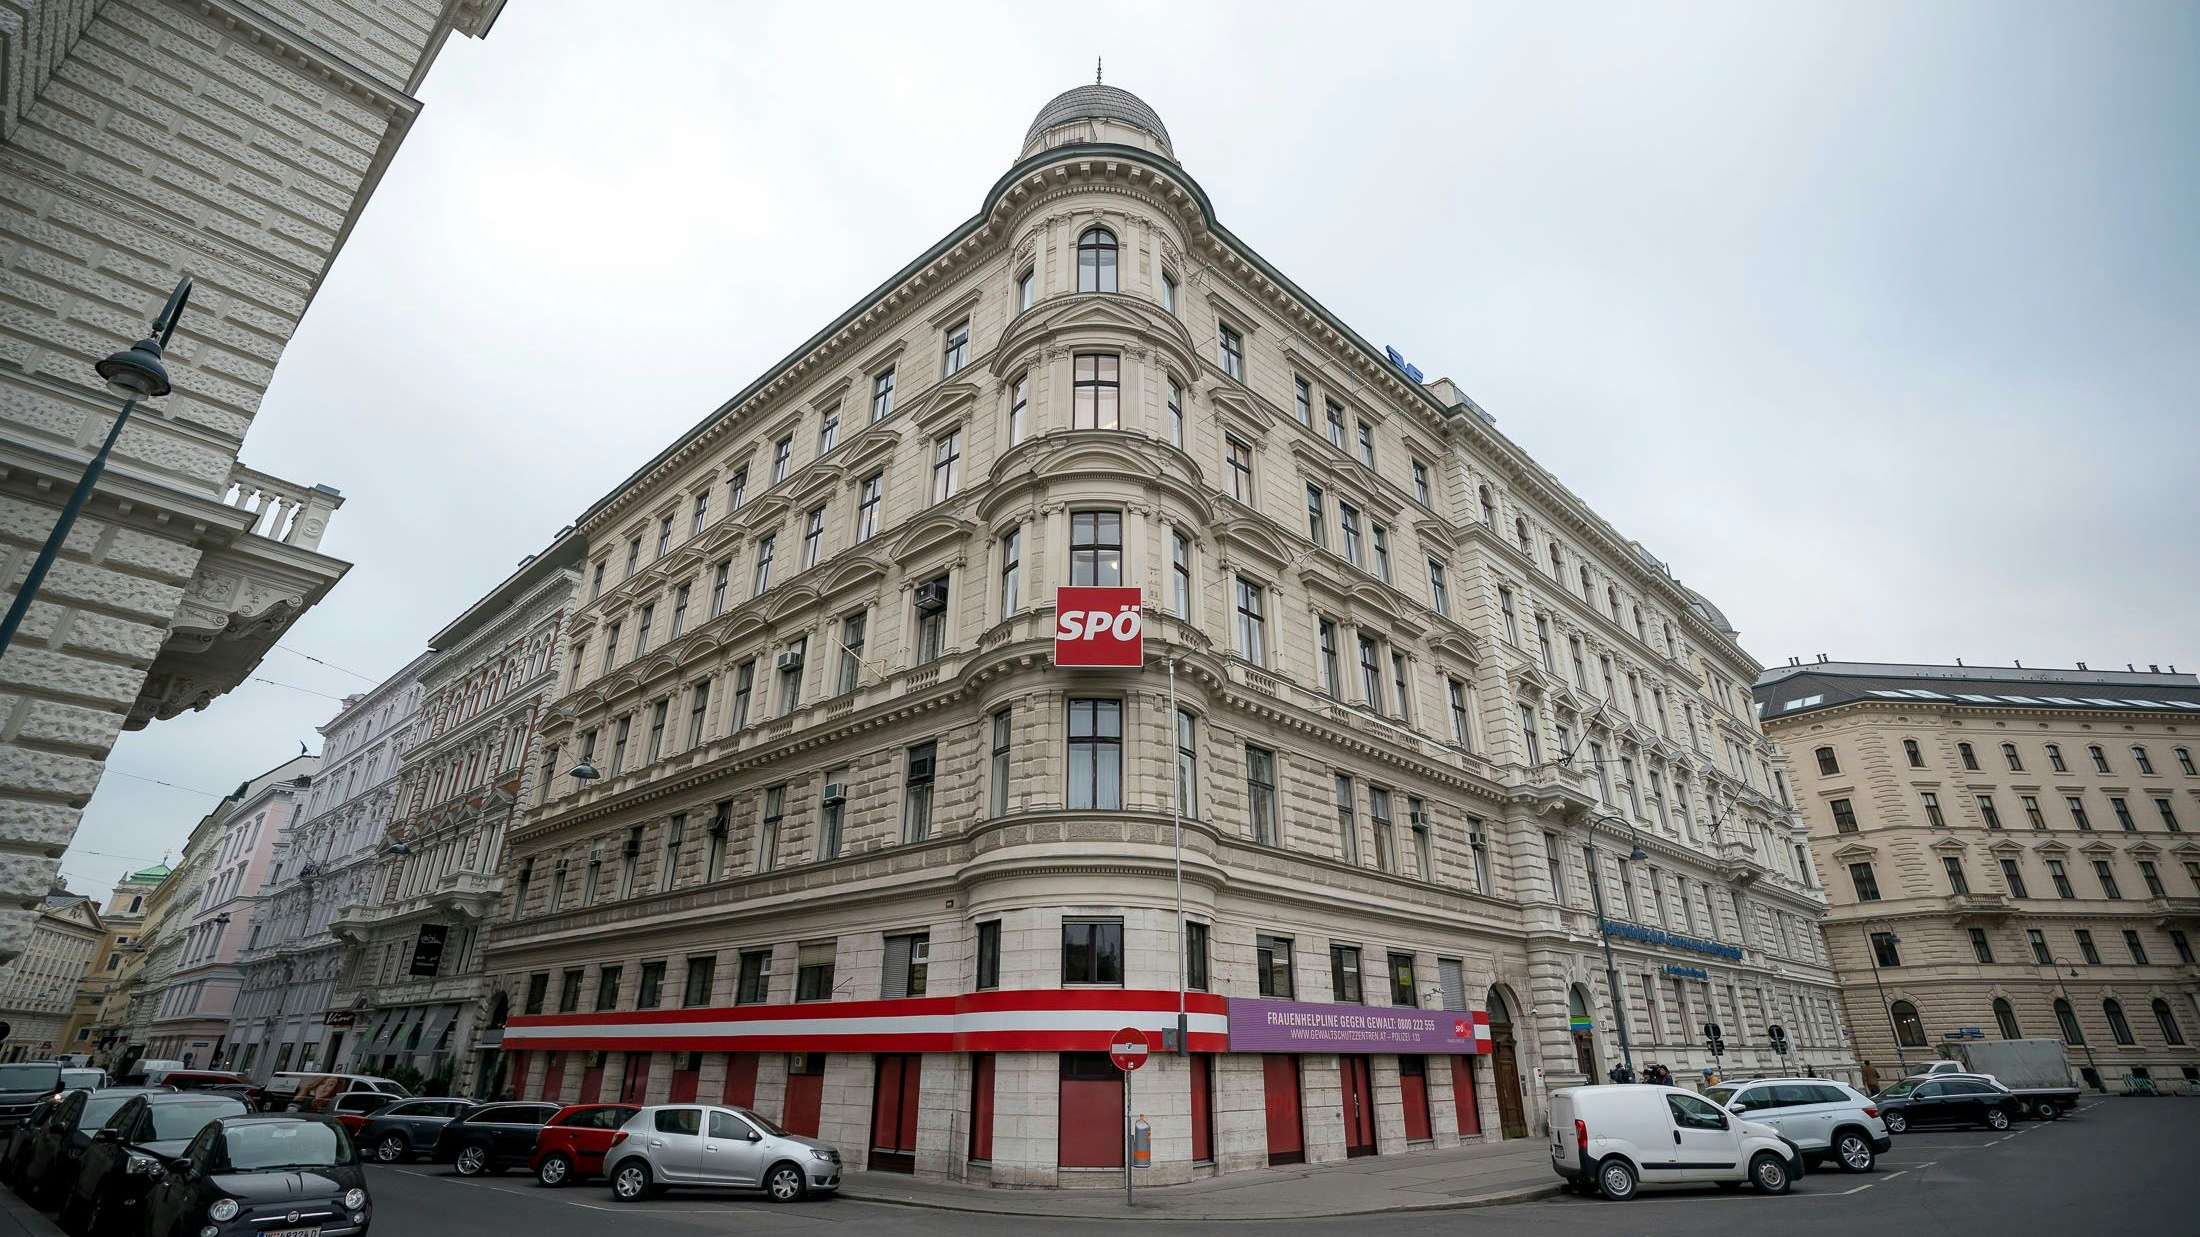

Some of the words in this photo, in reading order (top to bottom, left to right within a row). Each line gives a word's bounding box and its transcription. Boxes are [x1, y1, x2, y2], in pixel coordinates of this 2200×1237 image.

[1056, 605, 1141, 641] SPÖ
[1267, 1012, 1338, 1027] FRAUENHELPLINE
[1340, 1015, 1365, 1028] GEGEN
[1366, 1016, 1397, 1030] GEWALT:
[1397, 1018, 1412, 1030] 0800
[1412, 1019, 1424, 1030] 222
[1424, 1020, 1436, 1031] 555
[1290, 1029, 1386, 1041] WWW.GEWALTSCHUTZZENTREN.AT
[1391, 1032, 1411, 1042] POLIZEI:
[1412, 1033, 1421, 1042] 133
